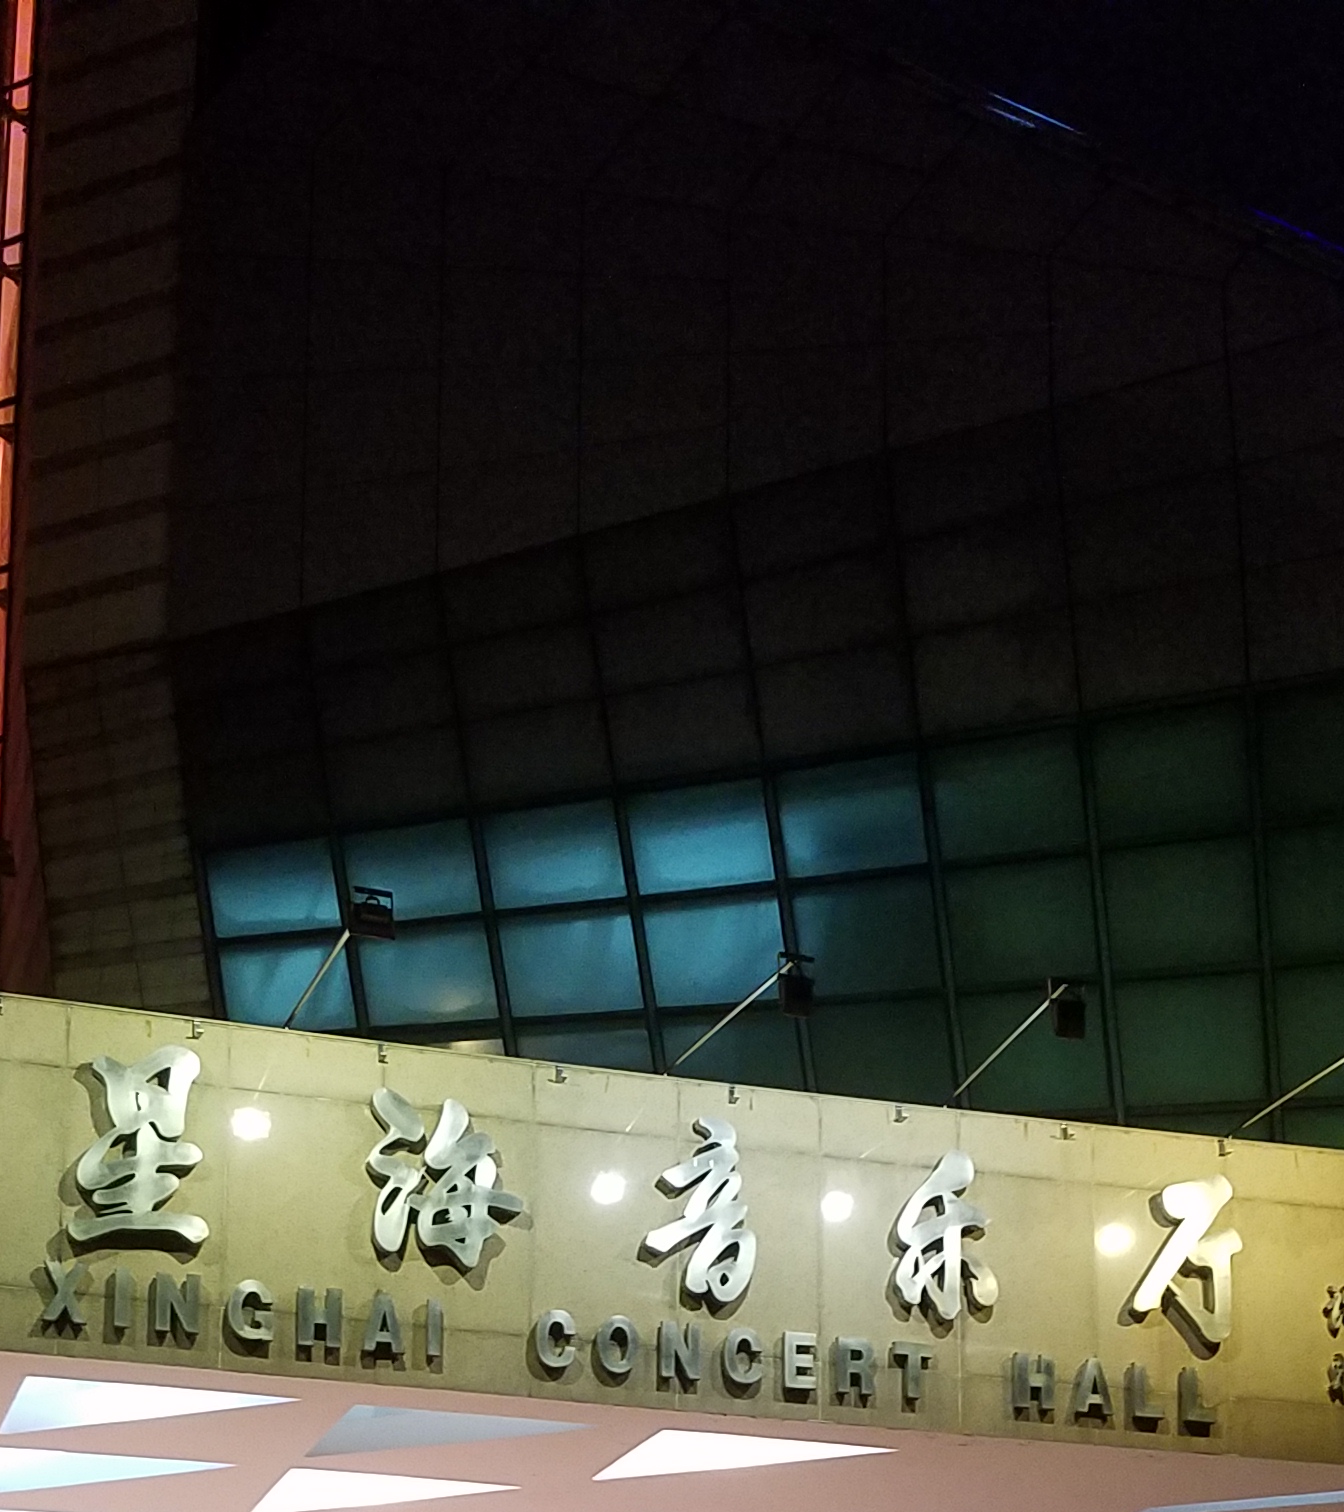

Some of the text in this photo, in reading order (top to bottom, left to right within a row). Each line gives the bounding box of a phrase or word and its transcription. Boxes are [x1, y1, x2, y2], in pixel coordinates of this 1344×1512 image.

[64, 1044, 1246, 1358] 星海音乐厅
[40, 1258, 1219, 1437] XINGHAI CONCERT HALL
